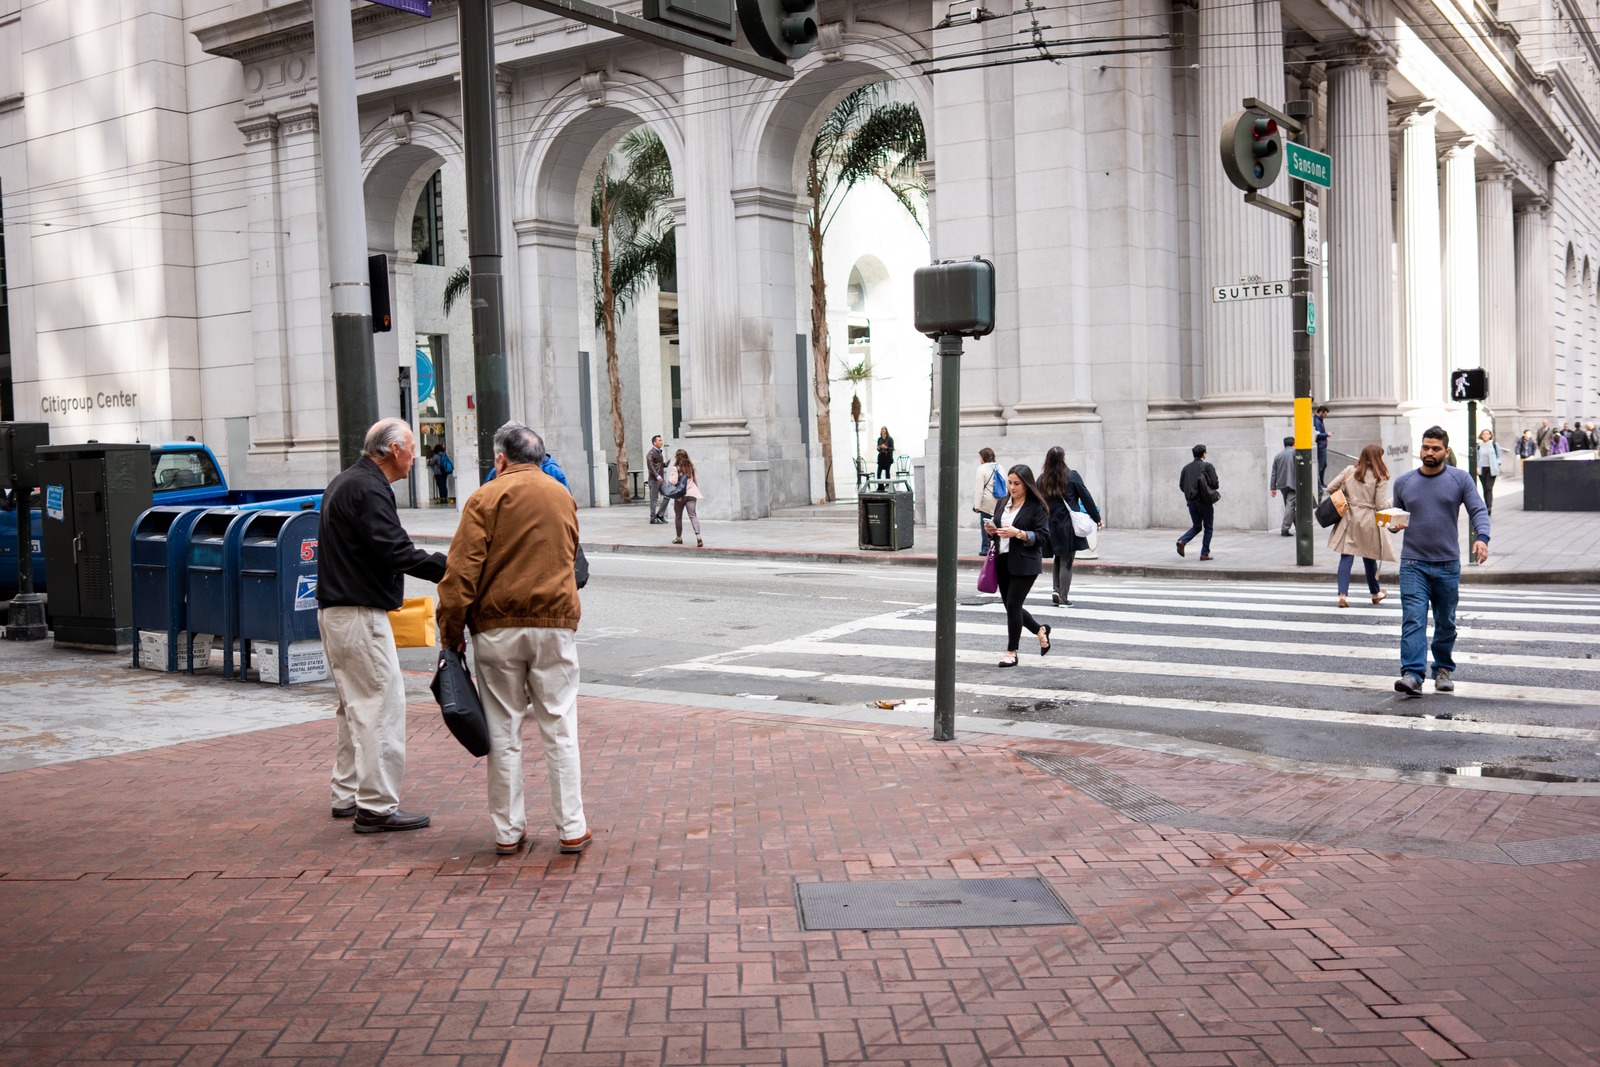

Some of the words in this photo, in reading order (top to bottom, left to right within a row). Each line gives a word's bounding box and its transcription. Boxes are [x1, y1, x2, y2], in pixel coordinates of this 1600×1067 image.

[1293, 152, 1326, 179] Sansome
[1309, 209, 1317, 223] BUS
[1308, 226, 1318, 242] LANE
[1307, 245, 1319, 260] AHEAD
[1218, 284, 1284, 299] SUTTER
[41, 396, 93, 414] Citigroup
[97, 390, 137, 408] Center
[301, 541, 314, 561] 5
